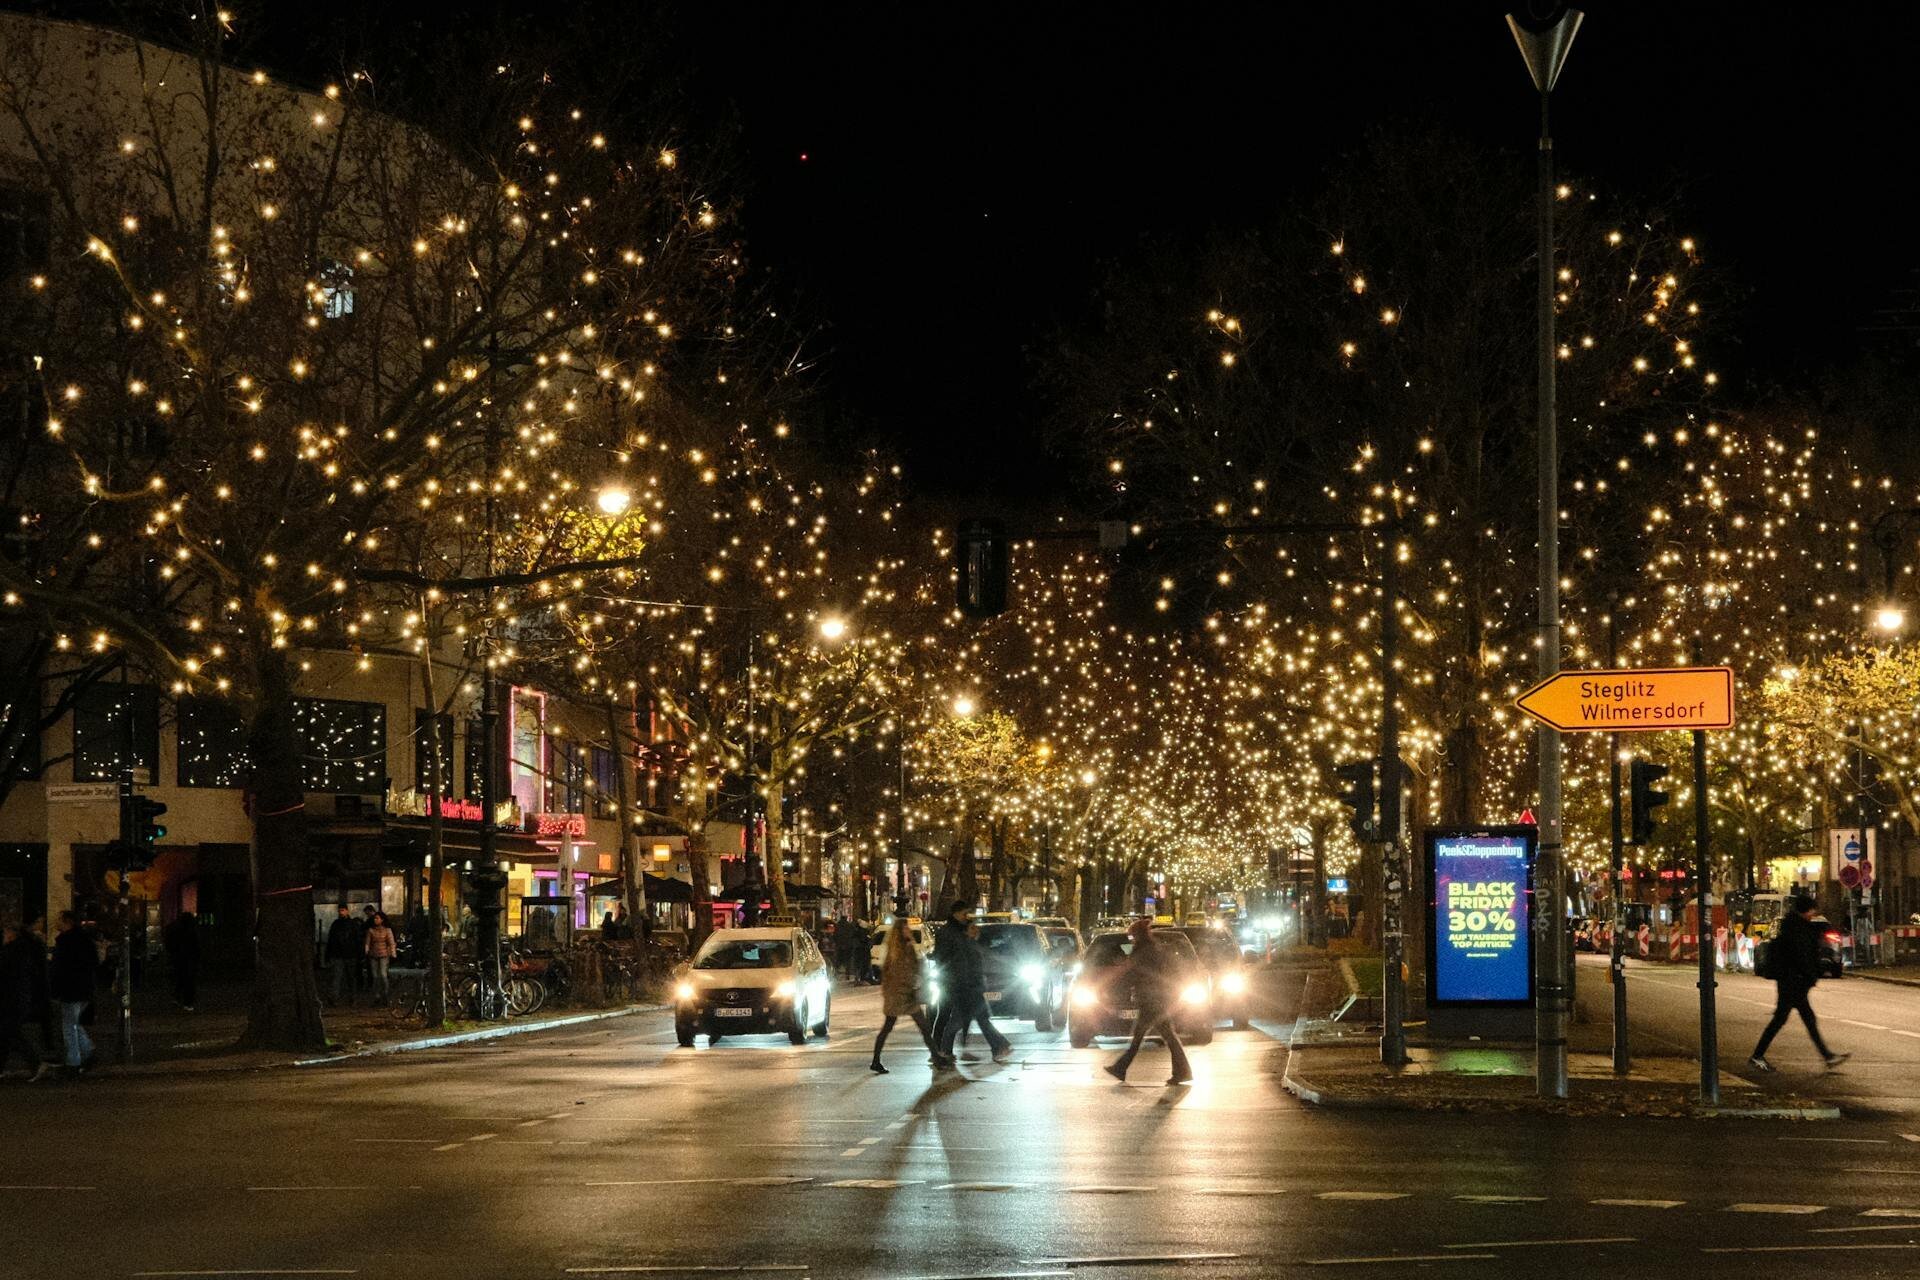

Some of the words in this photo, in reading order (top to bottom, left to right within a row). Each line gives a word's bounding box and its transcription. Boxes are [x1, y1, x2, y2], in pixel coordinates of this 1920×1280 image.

[1581, 681, 1655, 701] Steglitz
[1581, 702, 1705, 720] Wilmersdorf
[1439, 844, 1523, 858] Peek&Cloppenburg
[1449, 882, 1515, 895] BLACK
[1449, 896, 1515, 909] FRIDAY
[1449, 911, 1515, 931] 30%
